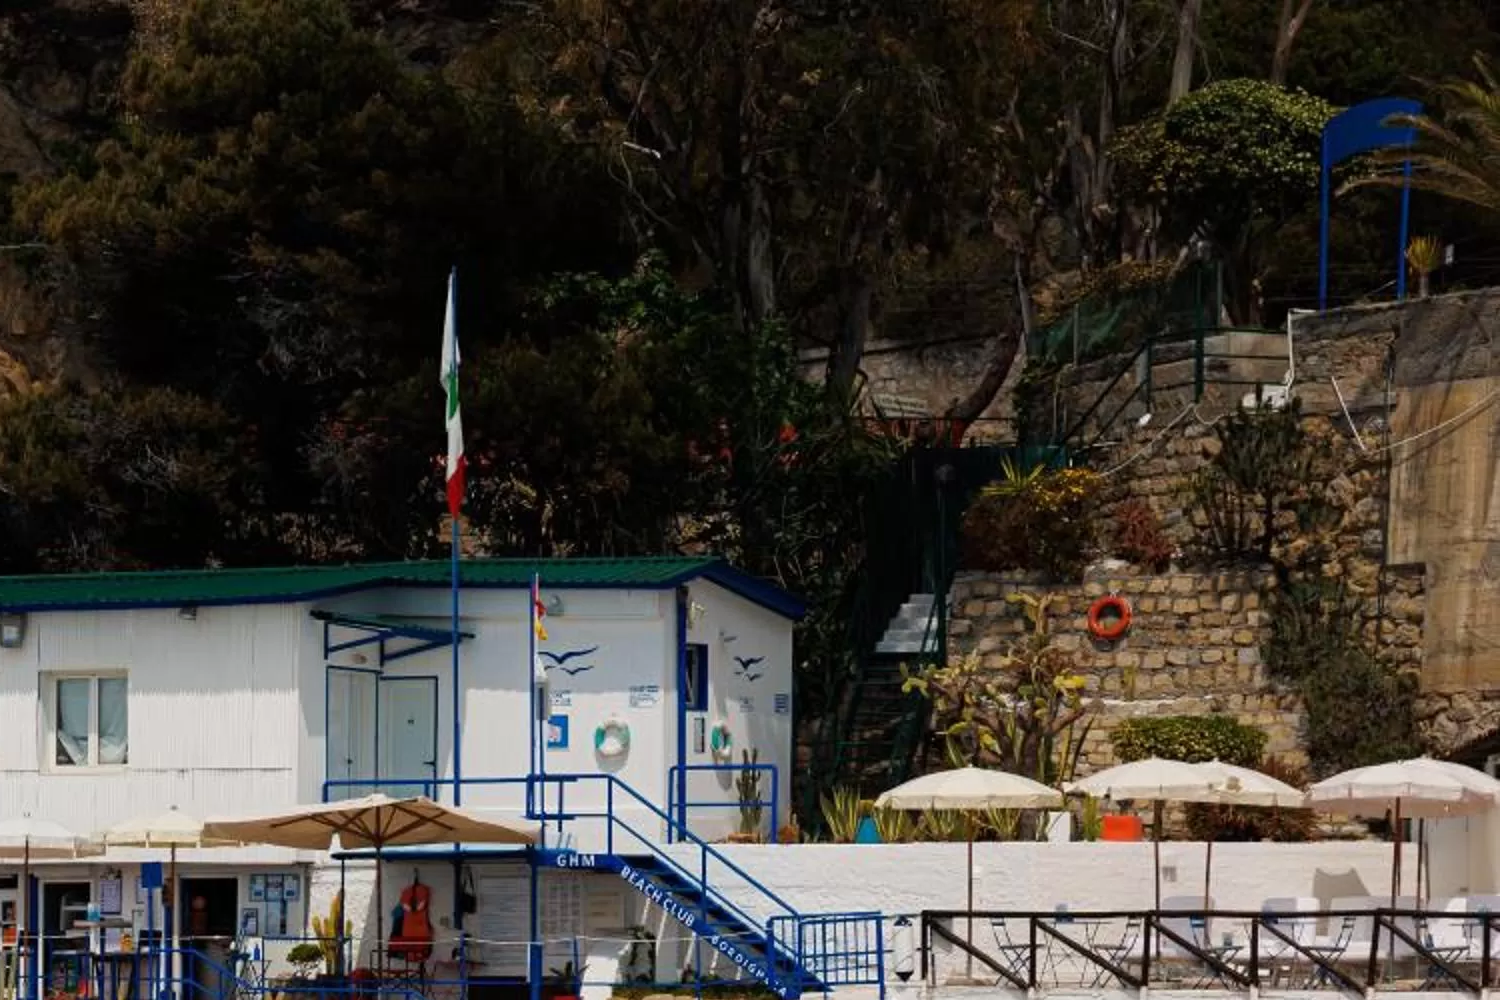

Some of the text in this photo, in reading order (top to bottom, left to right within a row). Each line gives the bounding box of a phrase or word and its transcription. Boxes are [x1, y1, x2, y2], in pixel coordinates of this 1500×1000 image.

[556, 855, 787, 996] GHM BEACH CLUB BORDIGHA
